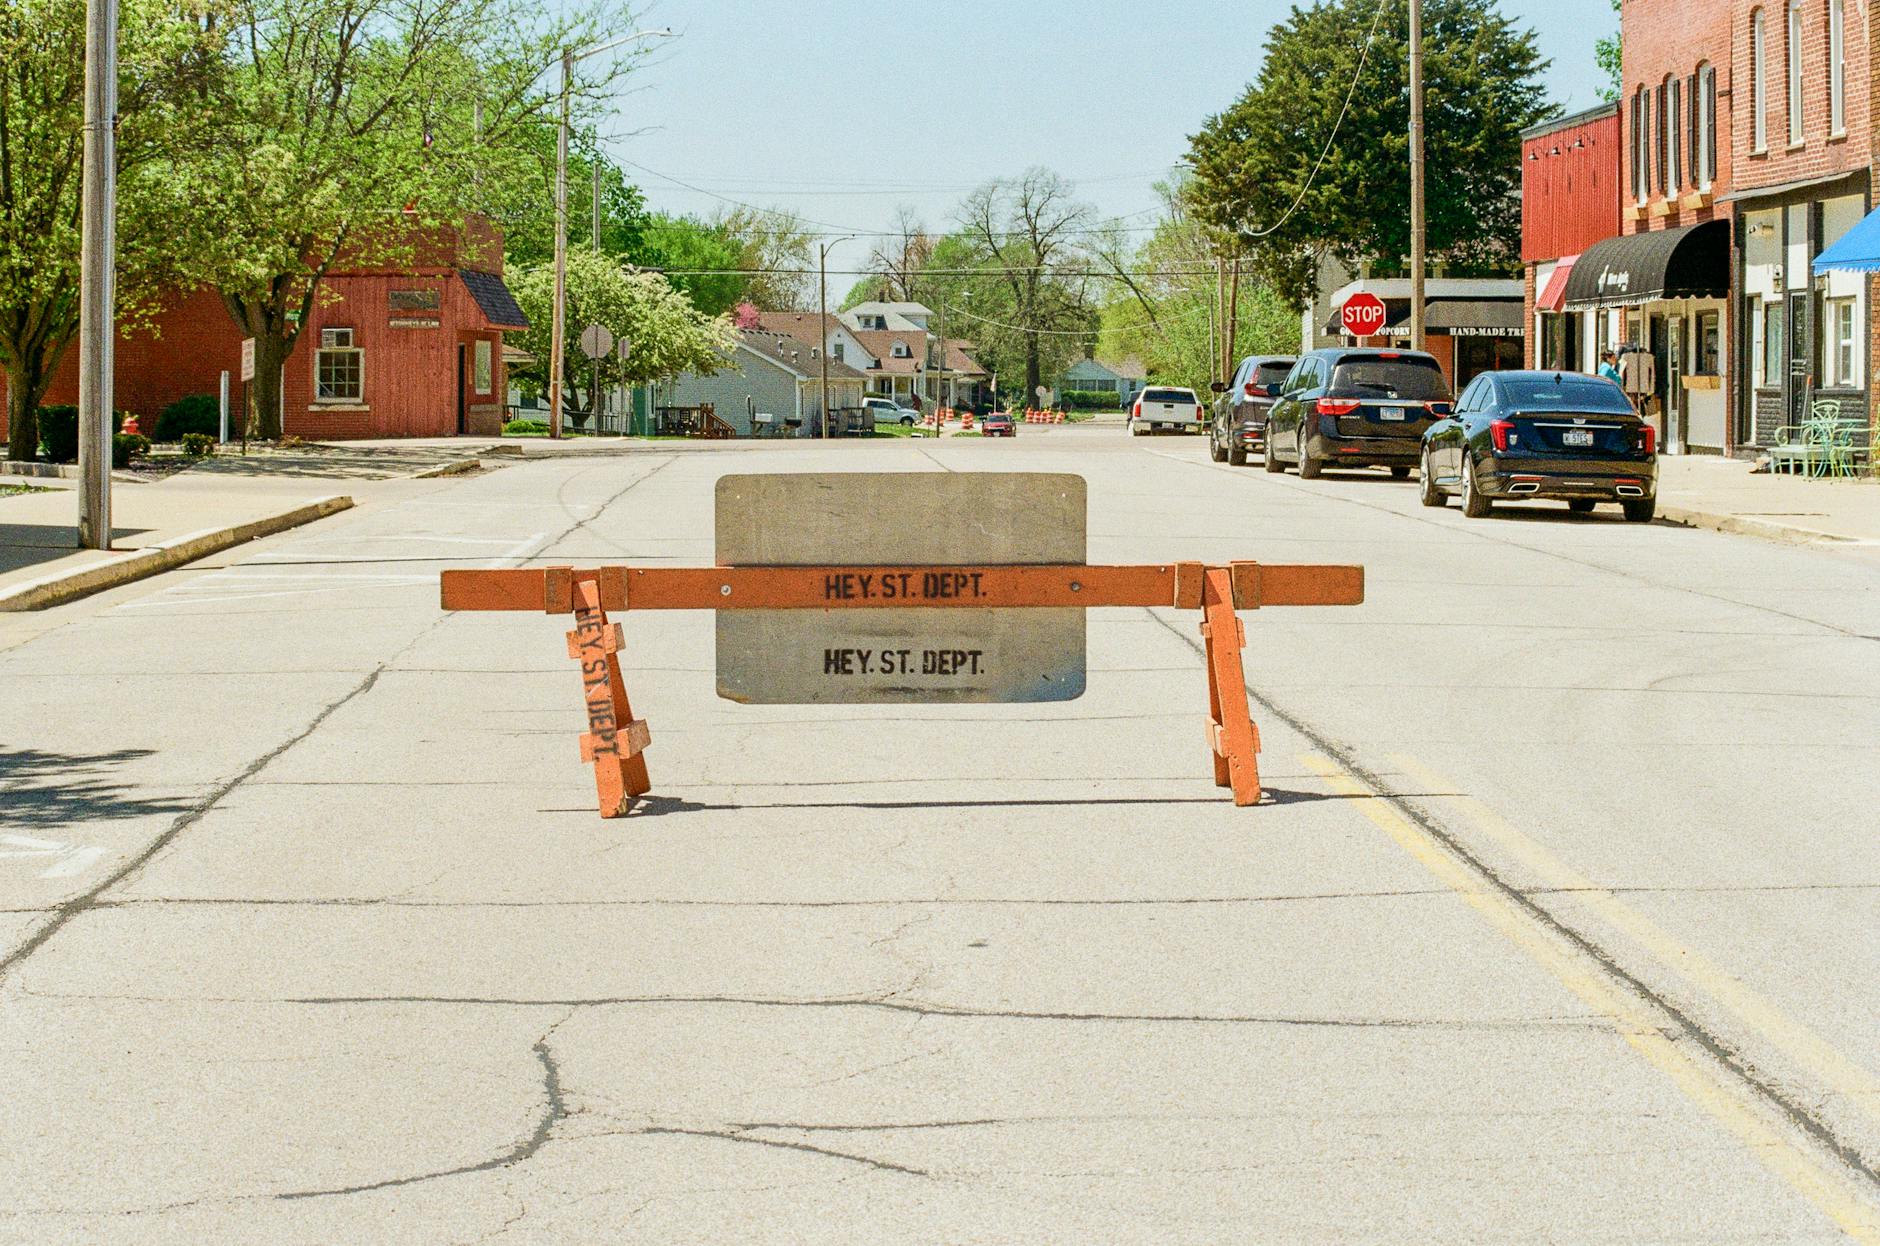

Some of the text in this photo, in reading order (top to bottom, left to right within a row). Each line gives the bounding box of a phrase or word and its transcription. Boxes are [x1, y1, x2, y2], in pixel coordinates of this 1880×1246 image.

[1344, 306, 1382, 323] STOP
[1449, 327, 1506, 337] HAND-MADE
[825, 573, 987, 599] HEY. ST. DEPT.
[824, 649, 985, 675] HEY. ST. DEPT.
[587, 699, 621, 761] DEPT.
